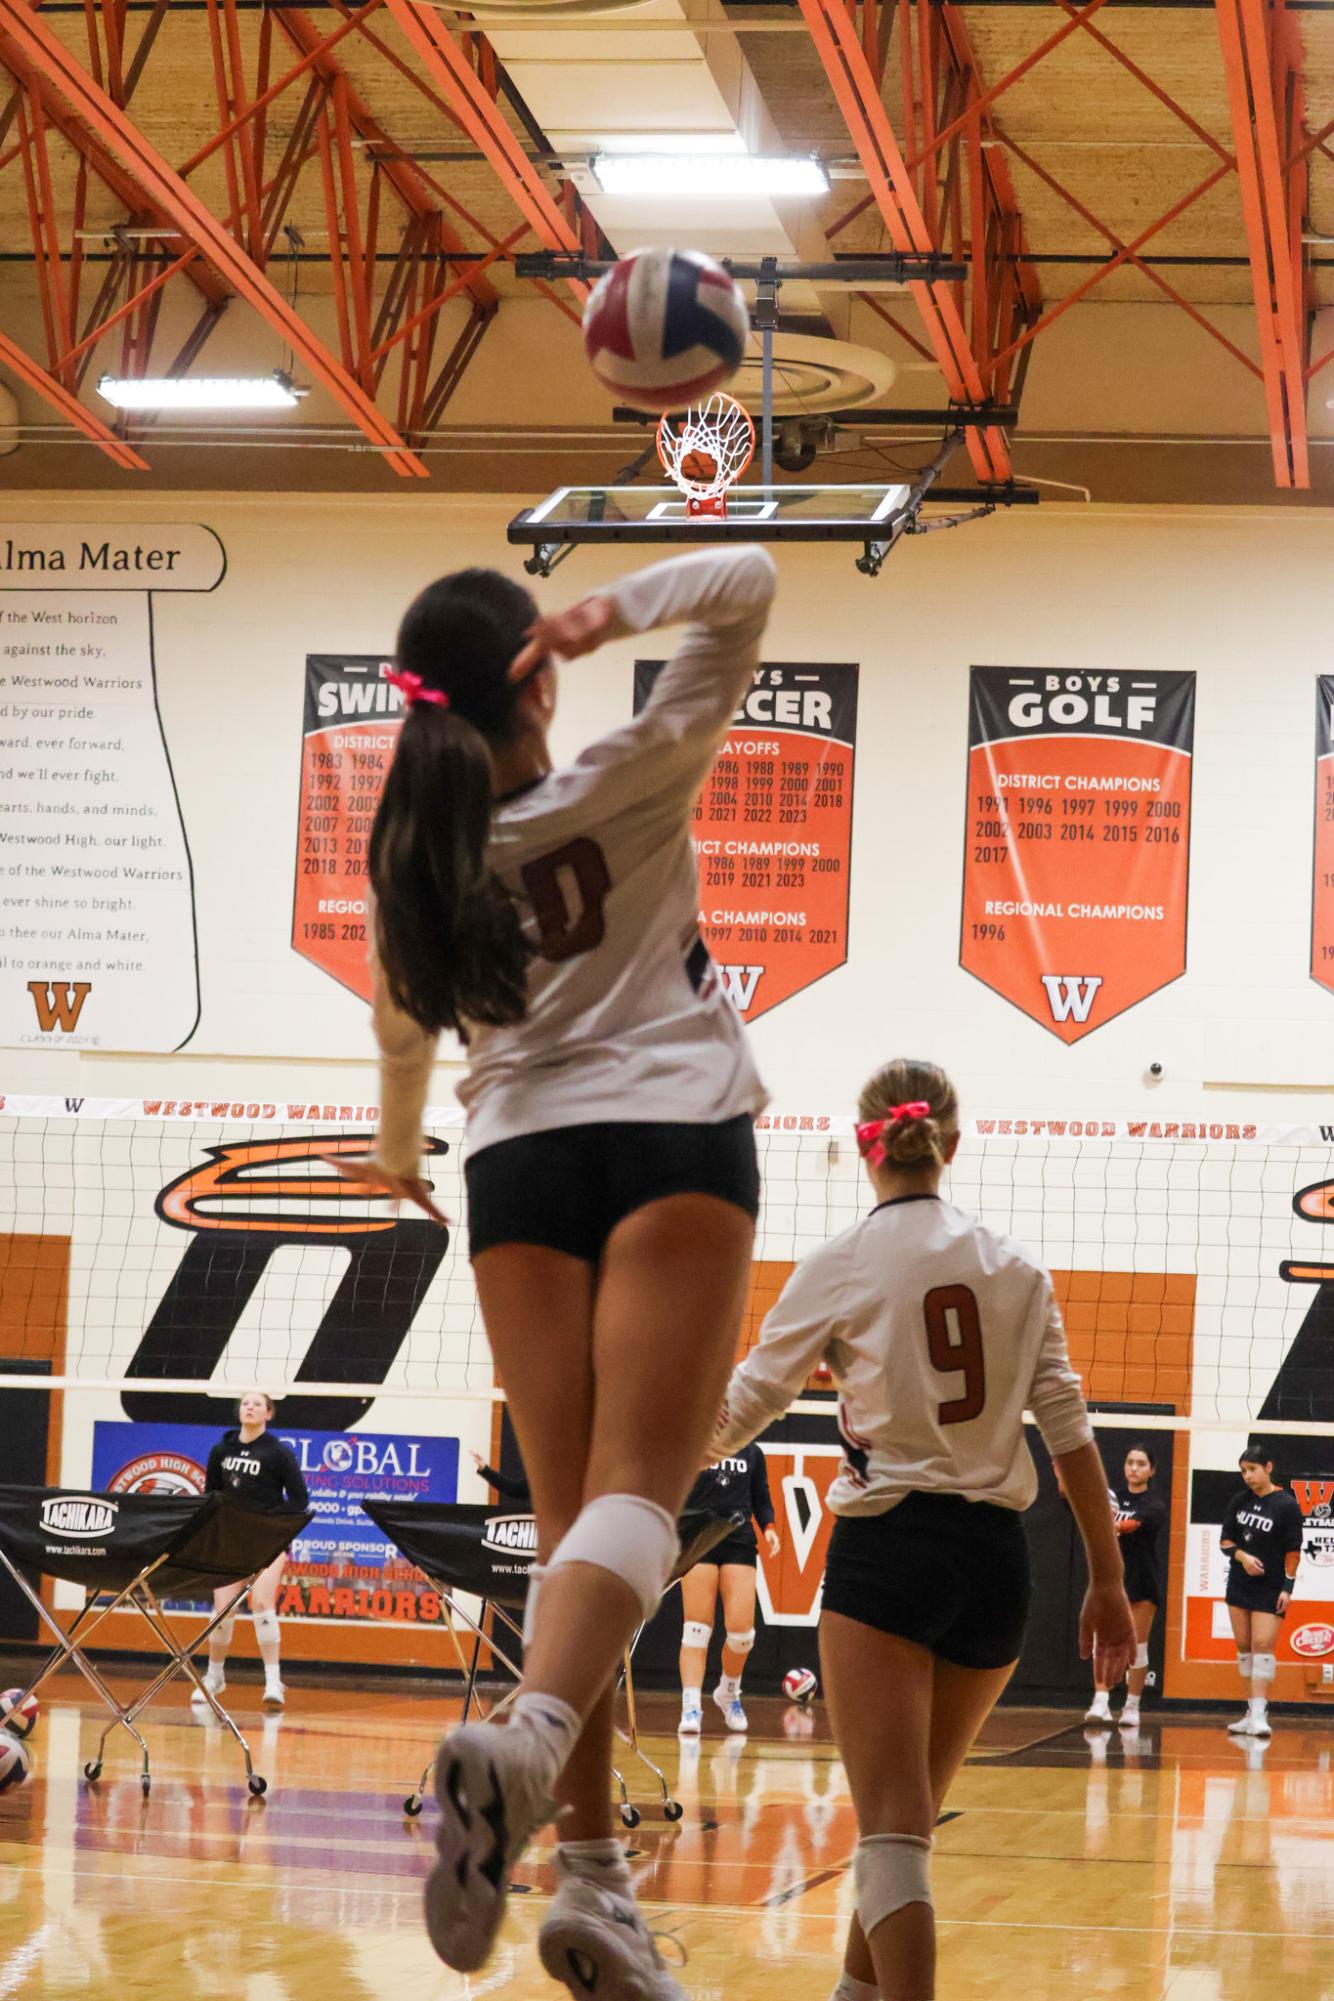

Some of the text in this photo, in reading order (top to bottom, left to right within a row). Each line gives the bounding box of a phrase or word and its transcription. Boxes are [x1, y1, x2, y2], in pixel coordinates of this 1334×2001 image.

[0, 540, 181, 571] lma Mater
[7, 611, 28, 624] the
[32, 611, 63, 624] West
[68, 611, 118, 625] horizon
[3, 643, 51, 659] against
[55, 643, 77, 656] the
[12, 675, 79, 689] Westwood
[83, 676, 143, 690] Warriors
[752, 670, 783, 686] YS
[1045, 675, 1120, 693] BOYS
[12, 704, 29, 720] by
[32, 708, 55, 719] our
[731, 690, 832, 730] CER
[1008, 692, 1157, 731] GOLF
[36, 739, 65, 750] ever
[334, 735, 396, 750] DISTRICT
[716, 742, 780, 756] AYOFFS
[311, 752, 384, 770] 1983 1984
[746, 761, 774, 776] 1988
[781, 762, 809, 776] 1989
[51, 770, 80, 781] ever
[310, 774, 340, 791] 1992
[711, 776, 843, 792] 1998 1999 2000 2001
[998, 774, 1161, 792] DISTRICT CHAMPIONS
[306, 795, 340, 812] 2002
[744, 792, 773, 807] 2010
[814, 794, 843, 808] 2018
[1018, 797, 1053, 815] 1996
[1062, 798, 1096, 816] 1997
[1104, 800, 1139, 817] 1999
[1146, 801, 1182, 819] 2000
[83, 803, 108, 816] and
[708, 807, 737, 822] 2021
[743, 808, 772, 823] 2022
[778, 809, 807, 824] 2023
[305, 815, 372, 833] 2007 200
[1017, 822, 1052, 840] 2003
[1060, 823, 1095, 841] 2014
[1103, 825, 1138, 843] 2015
[1145, 826, 1180, 844] 2016
[104, 838, 127, 847] our
[345, 837, 370, 855] 201
[724, 841, 820, 857] CHAMPIONS
[974, 846, 1009, 864] 2017
[8, 864, 22, 877] of
[25, 865, 46, 878] the
[51, 865, 119, 879] Westwood
[123, 867, 184, 881] Warriors
[303, 857, 369, 876] 2018 202
[707, 857, 840, 873] 1986 1989 1999 2000
[706, 872, 805, 888] 2019 2021 2023
[3, 898, 31, 908] ever
[35, 896, 70, 909] shine
[74, 899, 88, 910] so
[318, 899, 368, 915] REGIO
[984, 900, 1165, 920] REGIONAL CHAMPIONS
[711, 910, 807, 926] CHAMPIONS
[10, 926, 37, 939] thee
[41, 929, 63, 940] our
[66, 928, 102, 941] Alma
[303, 923, 367, 941] 1985 202
[738, 928, 767, 943] 2010
[774, 929, 803, 943] 2014
[809, 930, 837, 944] 2021
[972, 923, 1006, 942] 1996
[11, 958, 24, 970] to
[27, 960, 73, 972] orange
[76, 959, 102, 971] and
[27, 981, 92, 1033] W
[1041, 975, 1103, 1023] W
[64, 1097, 381, 1122] W WESTWOOD WARRIO
[755, 1115, 831, 1131] RIORS
[975, 1119, 1117, 1137] WESTWOOD
[1126, 1121, 1258, 1140] WARRIORS
[923, 1283, 986, 1426] 9
[279, 1436, 431, 1478] LOBAL
[709, 1457, 748, 1473] TTO
[114, 1458, 191, 1492] STWOOD HIGH
[342, 1476, 430, 1492] SOLUTIONS
[40, 1497, 117, 1533] TACHIKARA
[484, 1515, 538, 1550] TACHI
[292, 1539, 398, 1559] PROUD SPONSOR
